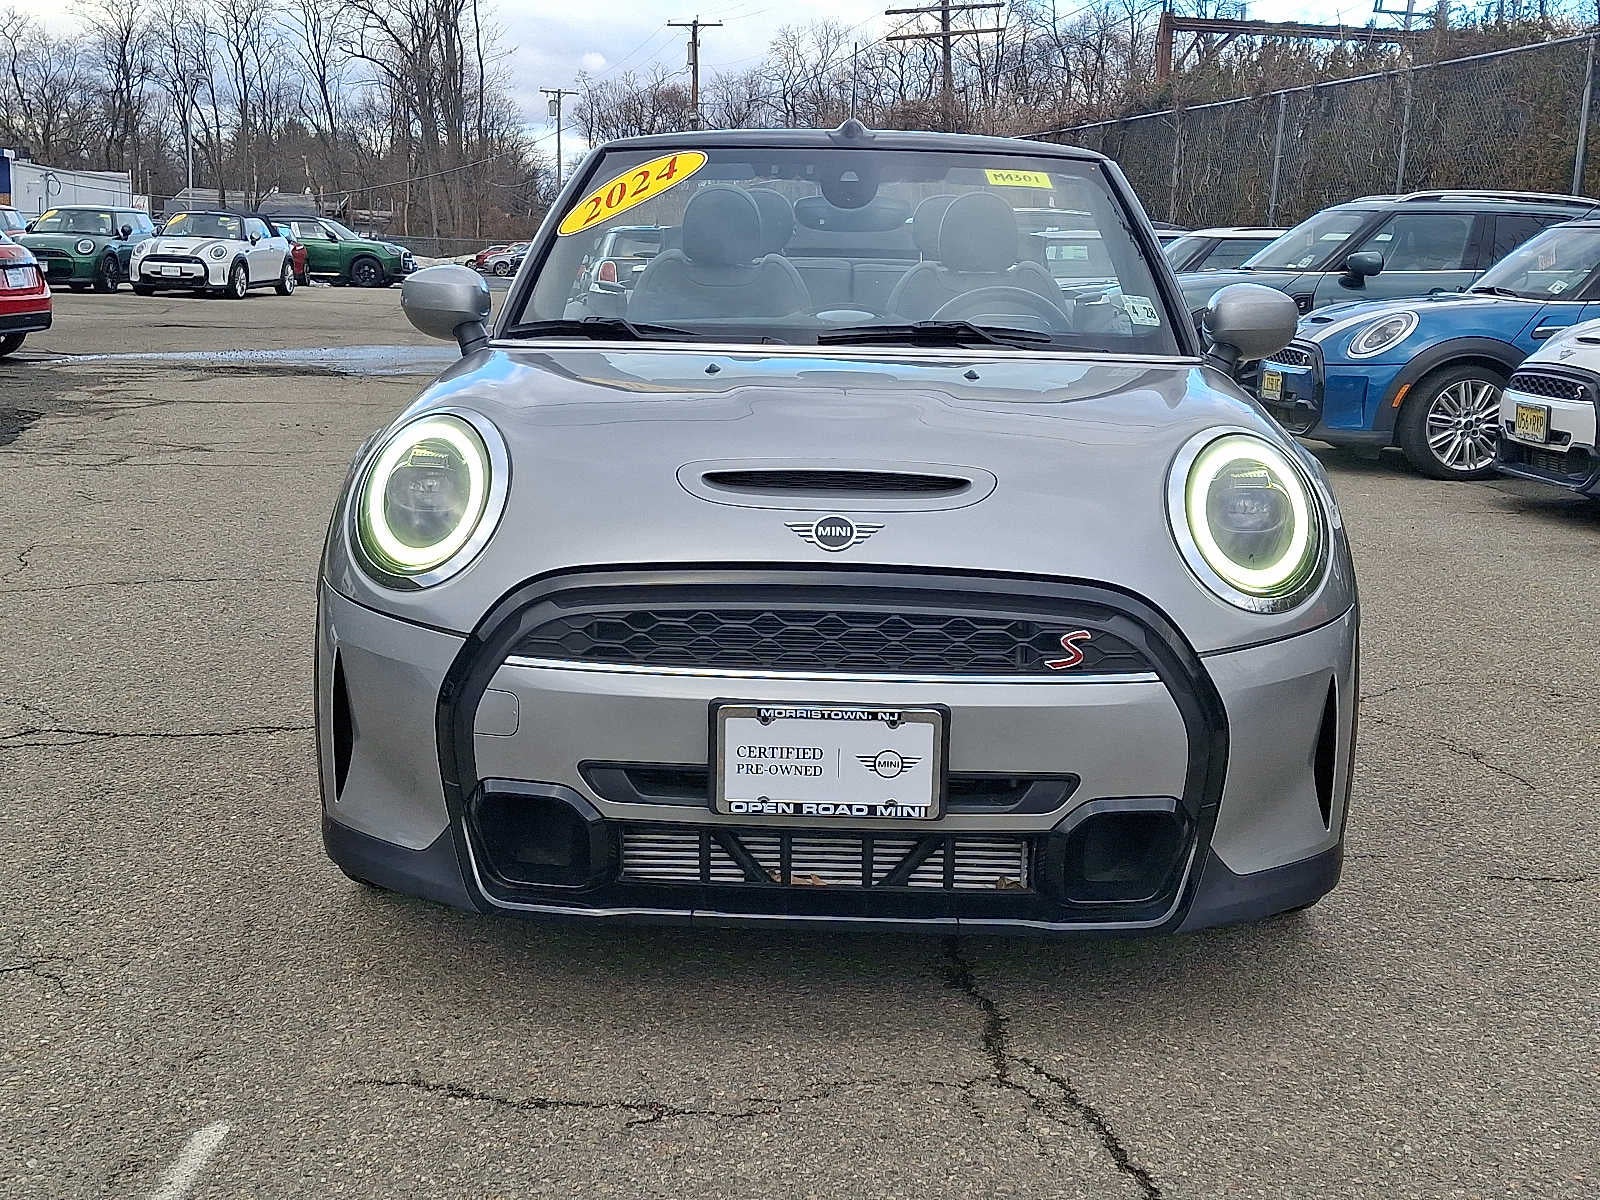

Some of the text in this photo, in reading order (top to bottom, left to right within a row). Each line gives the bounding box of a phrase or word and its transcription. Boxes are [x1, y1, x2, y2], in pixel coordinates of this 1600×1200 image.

[582, 155, 678, 226] 2024
[1142, 306, 1157, 319] 28
[817, 526, 851, 537] MINI
[1044, 630, 1092, 670] S
[760, 708, 899, 722] MORRISTOWN, NJ
[736, 745, 824, 761] CERTIFIED
[736, 763, 824, 777] PRE-OWNED
[877, 760, 900, 770] MINI
[730, 801, 927, 818] OPEN ROAD MINI
